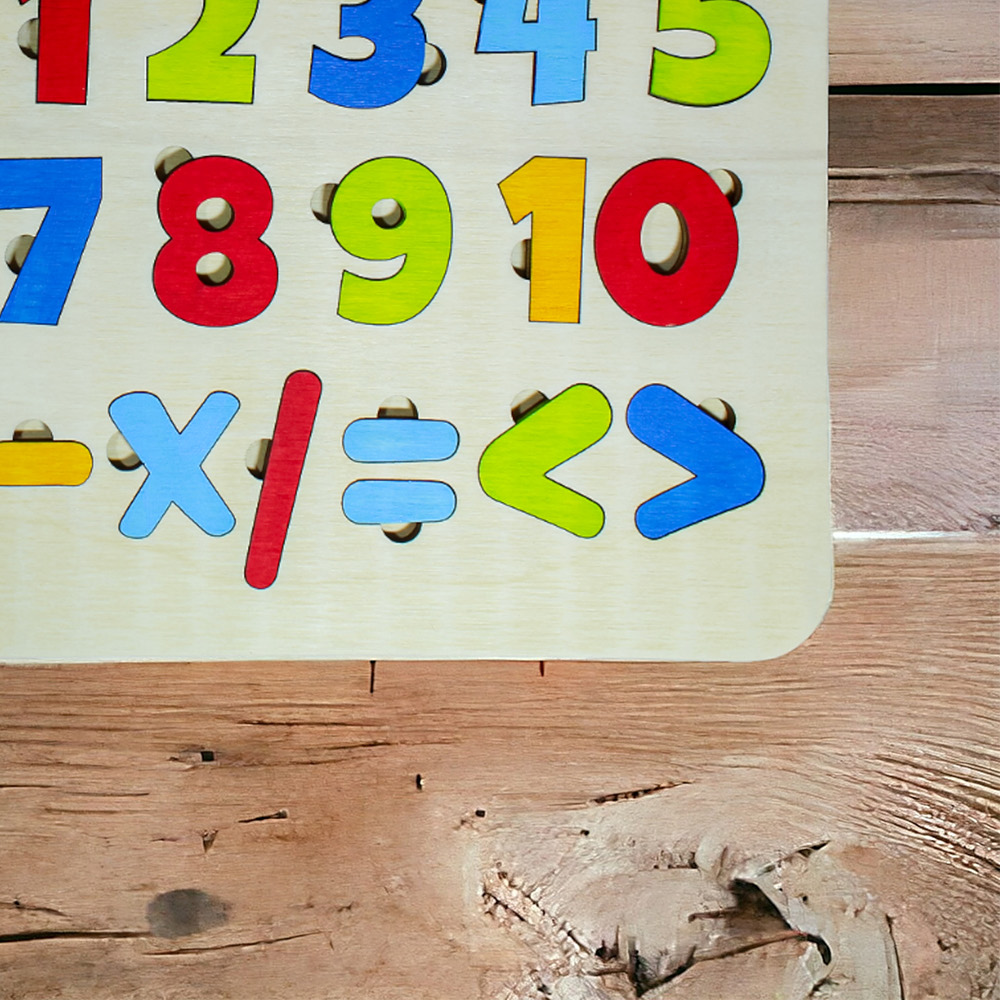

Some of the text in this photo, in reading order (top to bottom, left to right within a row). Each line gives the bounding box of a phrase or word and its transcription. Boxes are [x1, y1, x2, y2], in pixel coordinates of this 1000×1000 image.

[152, 155, 279, 328] 8
[329, 155, 453, 326] 9
[497, 155, 740, 328] 10
